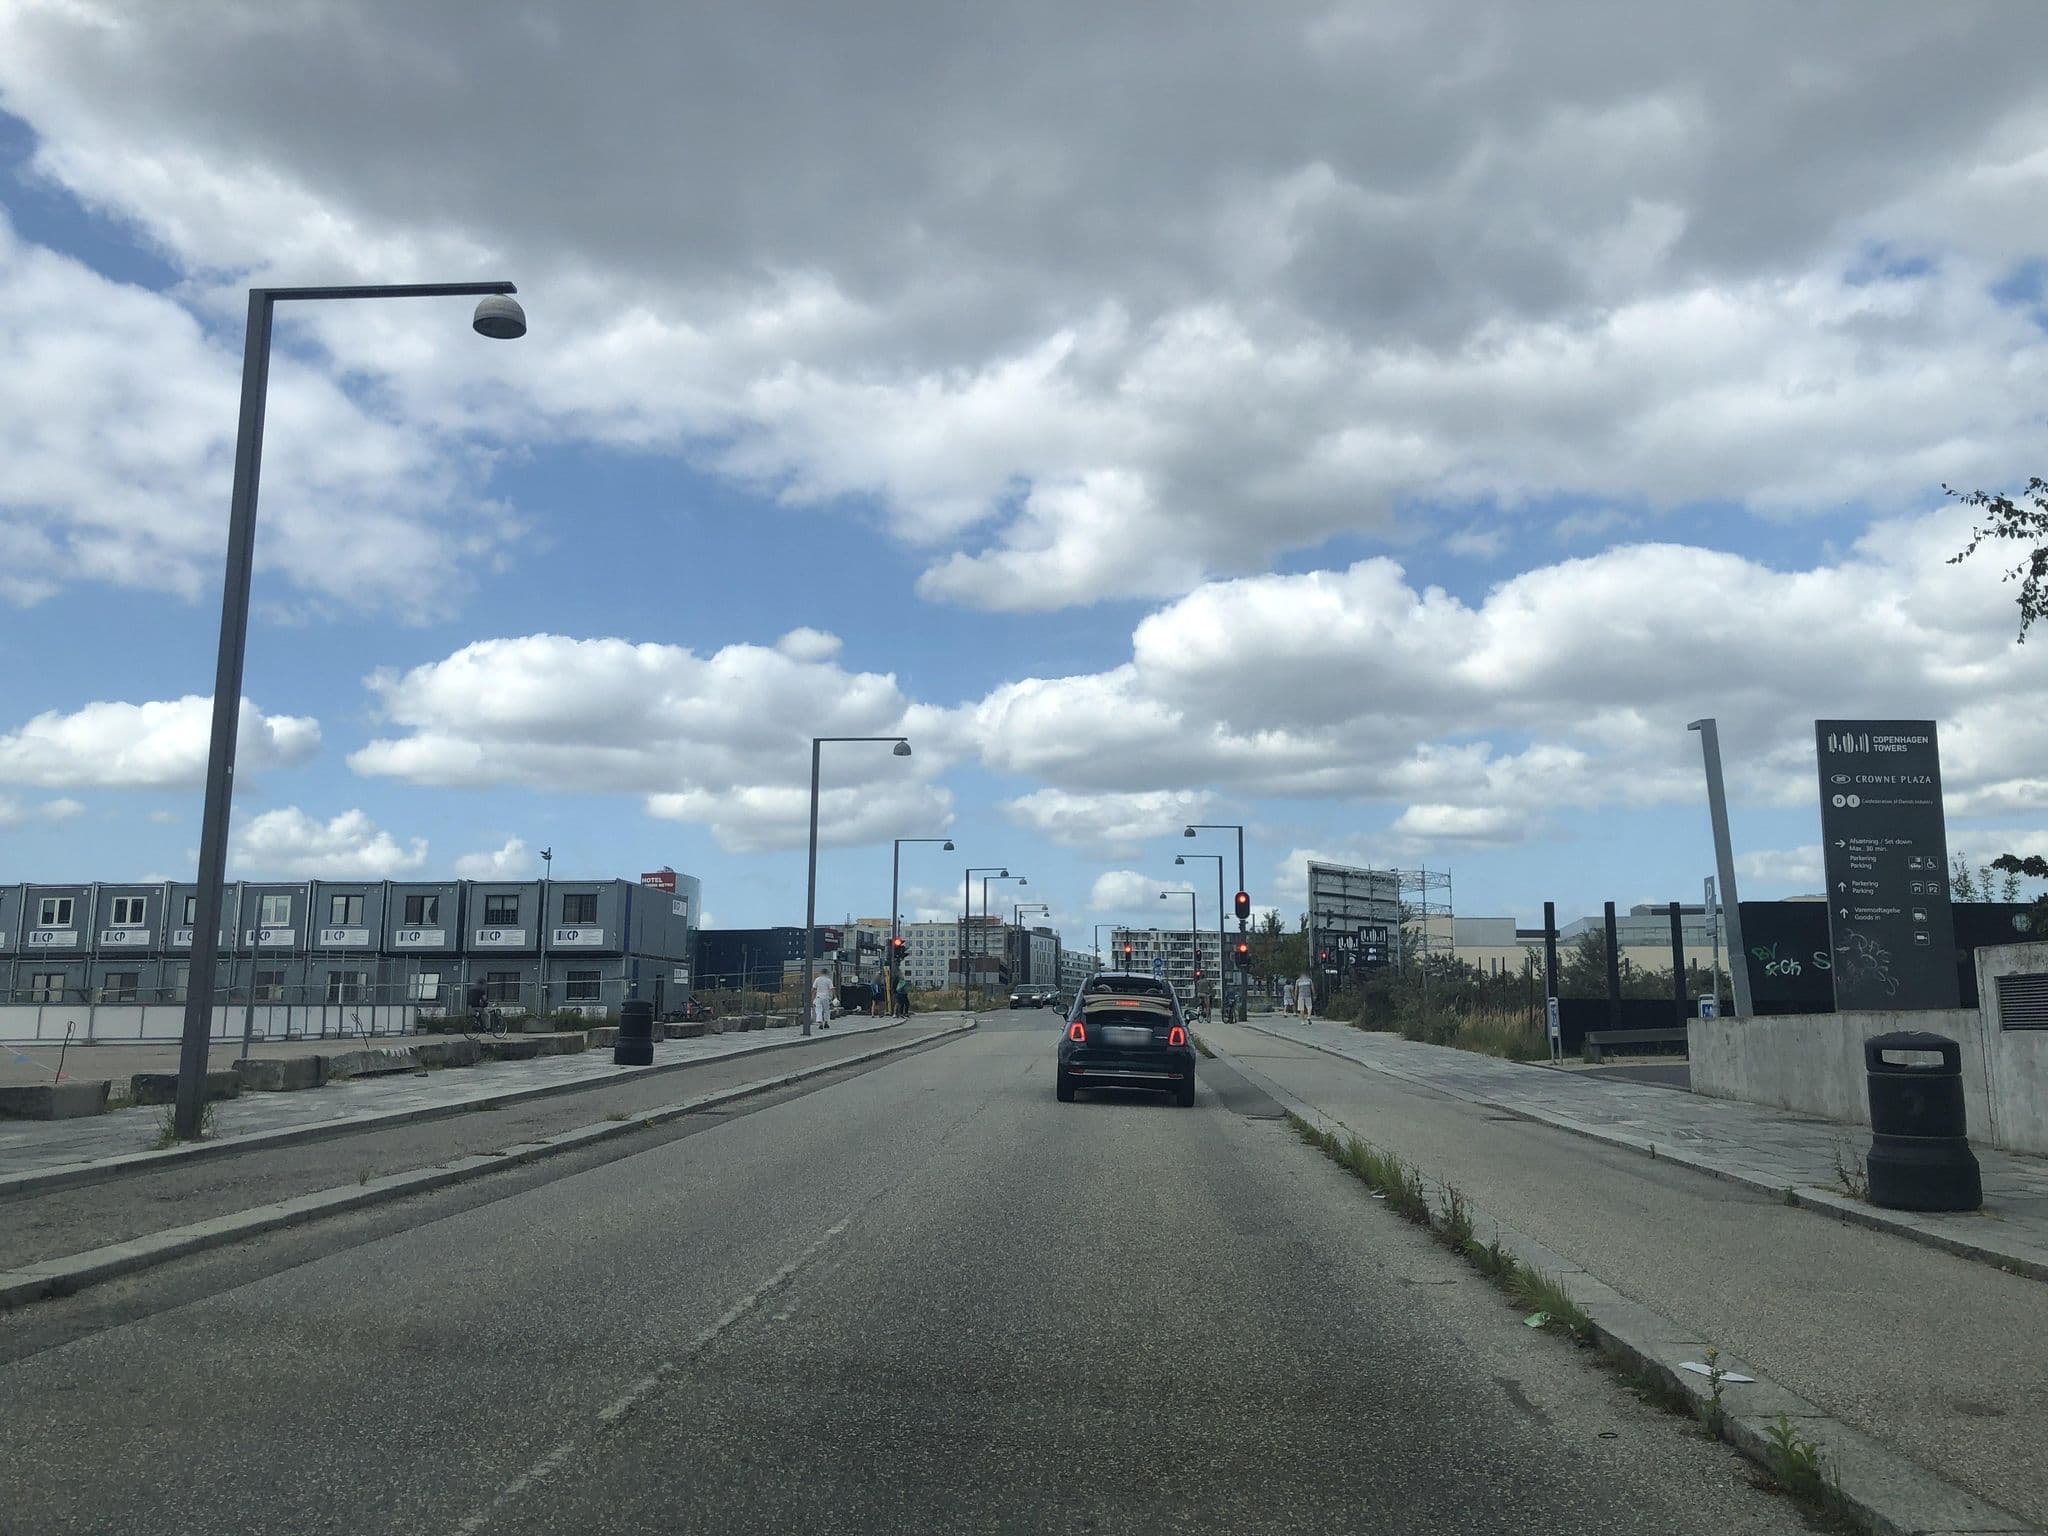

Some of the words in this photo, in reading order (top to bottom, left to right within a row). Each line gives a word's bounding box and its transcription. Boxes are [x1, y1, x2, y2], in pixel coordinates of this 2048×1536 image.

[1872, 735, 1929, 744] COPENHAGEN
[1873, 744, 1908, 752] TOWERS
[1855, 774, 1897, 784] CROWNE
[1901, 775, 1932, 784] PLAZA
[1852, 880, 1879, 888] Parkering
